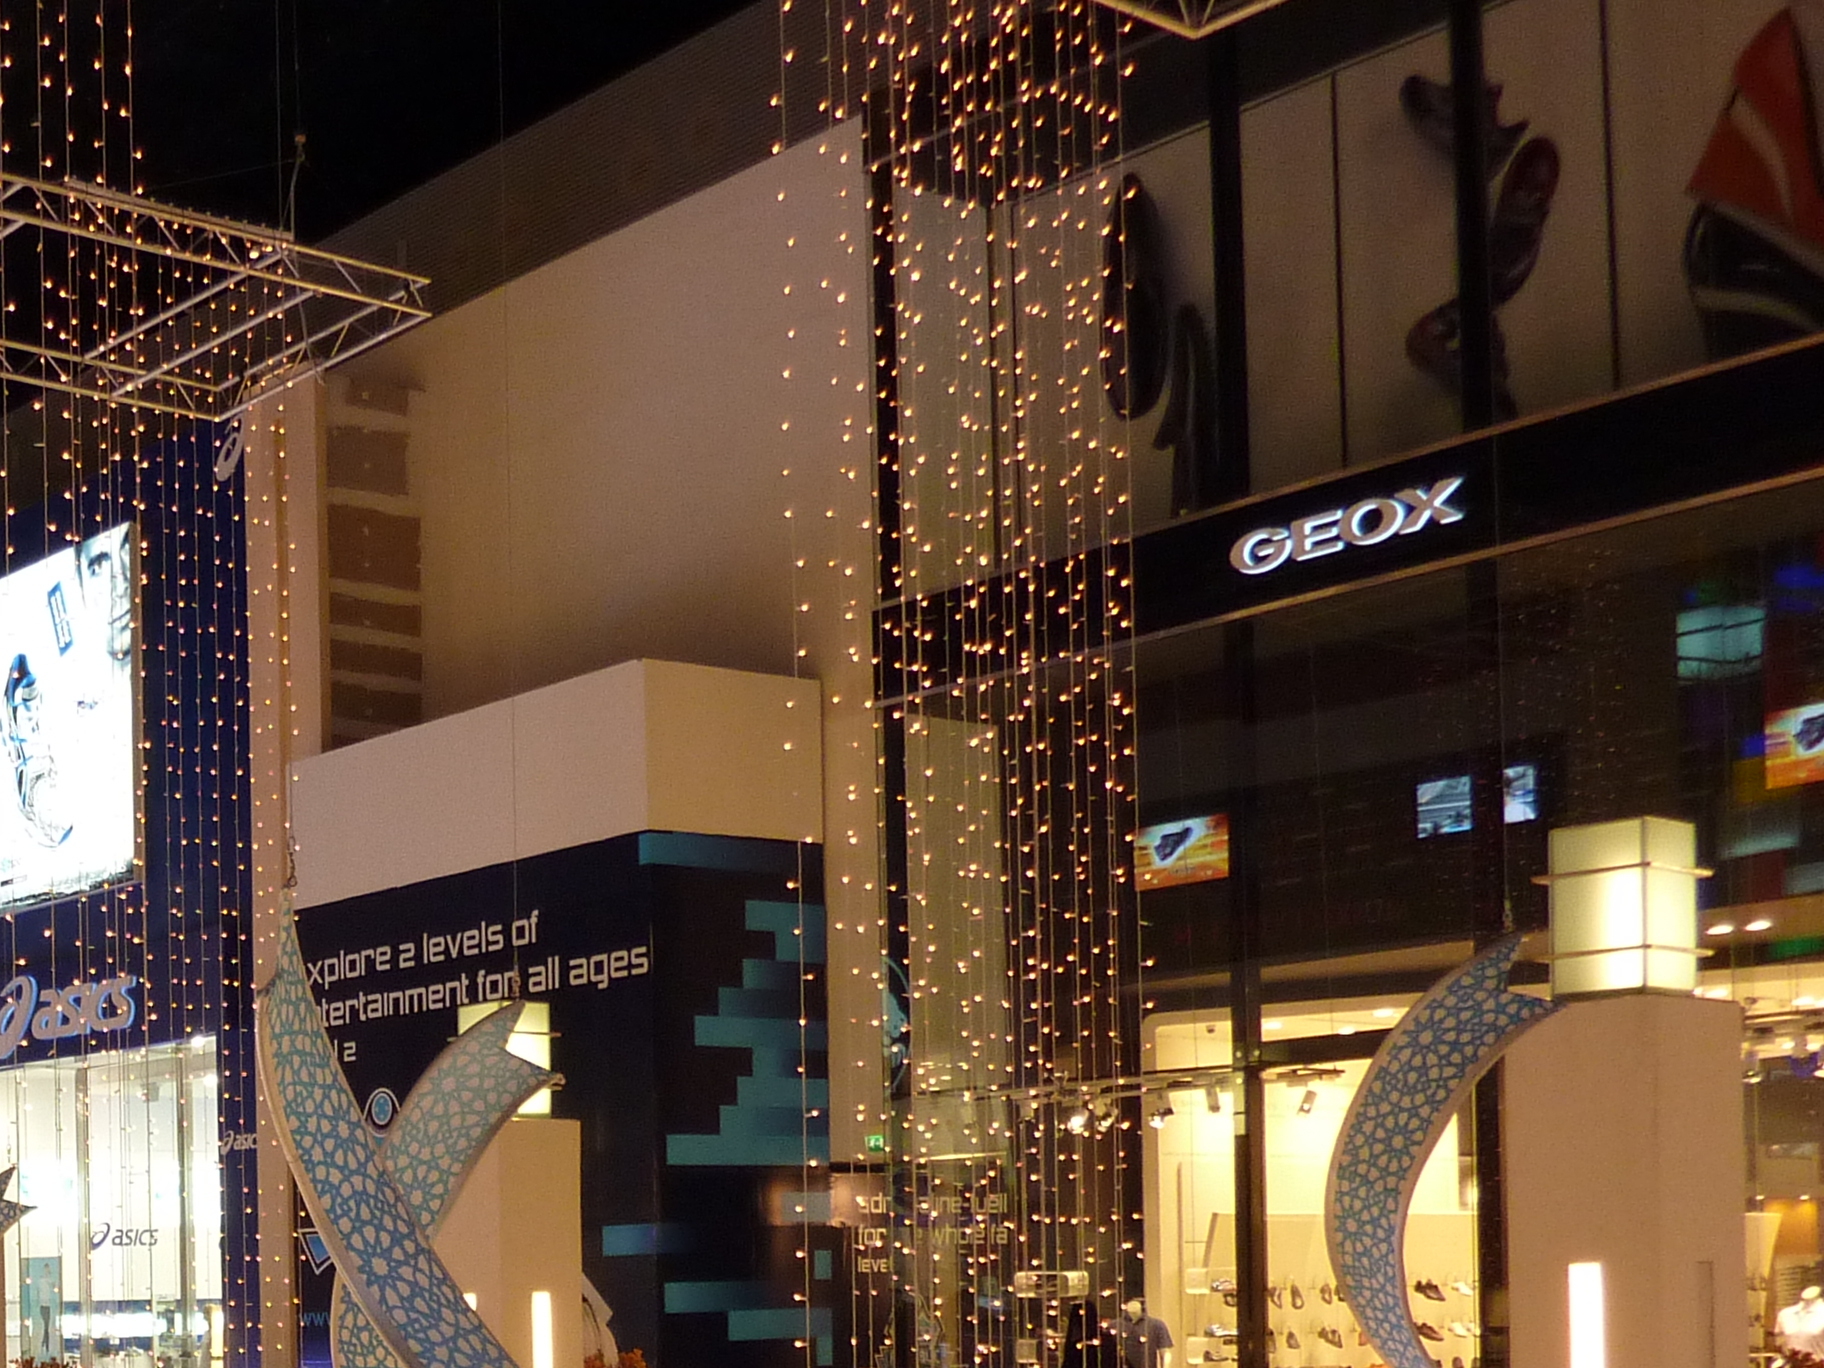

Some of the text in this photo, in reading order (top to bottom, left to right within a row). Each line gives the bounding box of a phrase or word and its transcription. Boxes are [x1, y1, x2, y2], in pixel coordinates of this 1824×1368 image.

[1229, 476, 1465, 575] GEOX
[398, 941, 416, 970] 2
[423, 919, 505, 965] levels
[511, 909, 540, 946] of
[477, 968, 521, 1003] for
[528, 954, 561, 994] all
[569, 944, 650, 991] ages
[111, 1228, 159, 1247] asics
